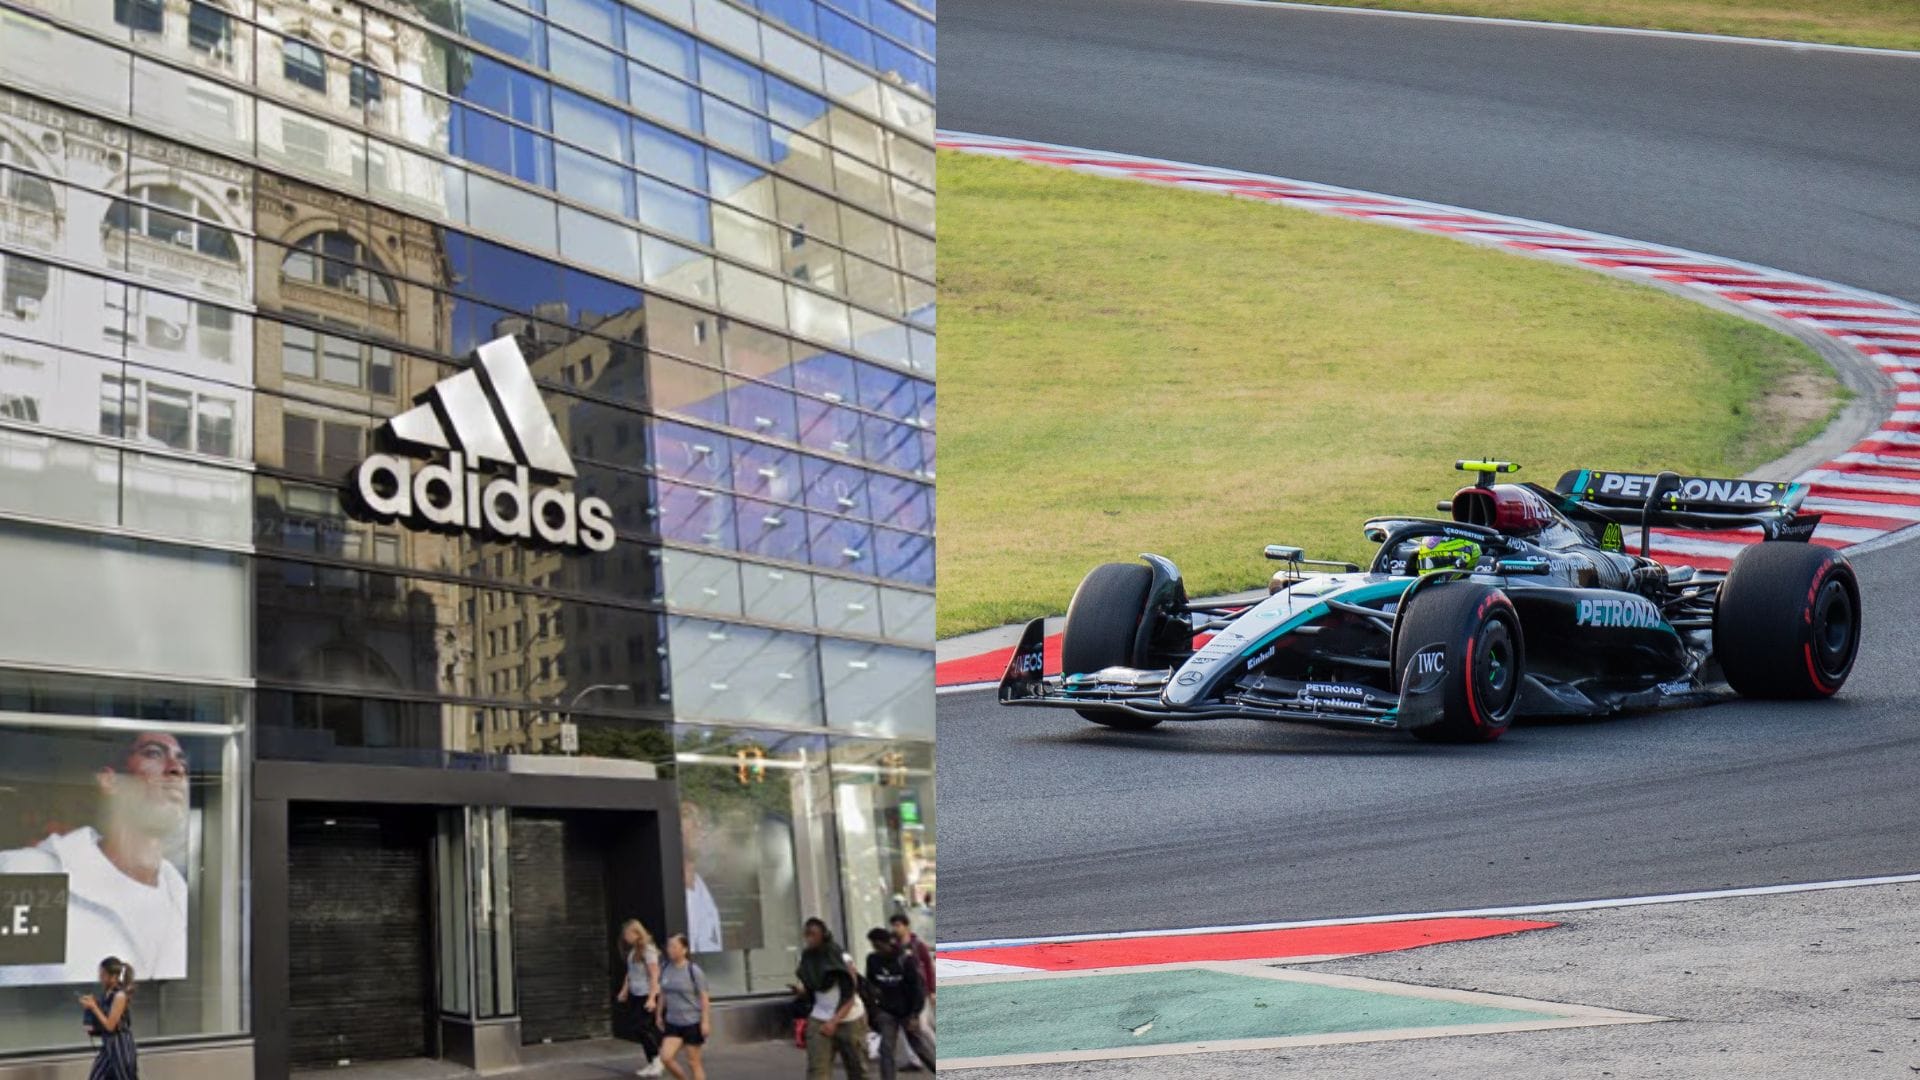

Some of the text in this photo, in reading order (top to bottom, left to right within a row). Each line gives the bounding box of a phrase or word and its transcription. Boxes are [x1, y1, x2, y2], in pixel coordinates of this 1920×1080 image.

[357, 450, 616, 552] adidas
[1600, 523, 1621, 552] 44
[1577, 599, 1661, 627] PETRONAS
[1013, 652, 1043, 674] INEOS
[1247, 645, 1276, 670] Einhell
[1418, 652, 1444, 674] IWC
[1306, 683, 1363, 696] PETRONAS
